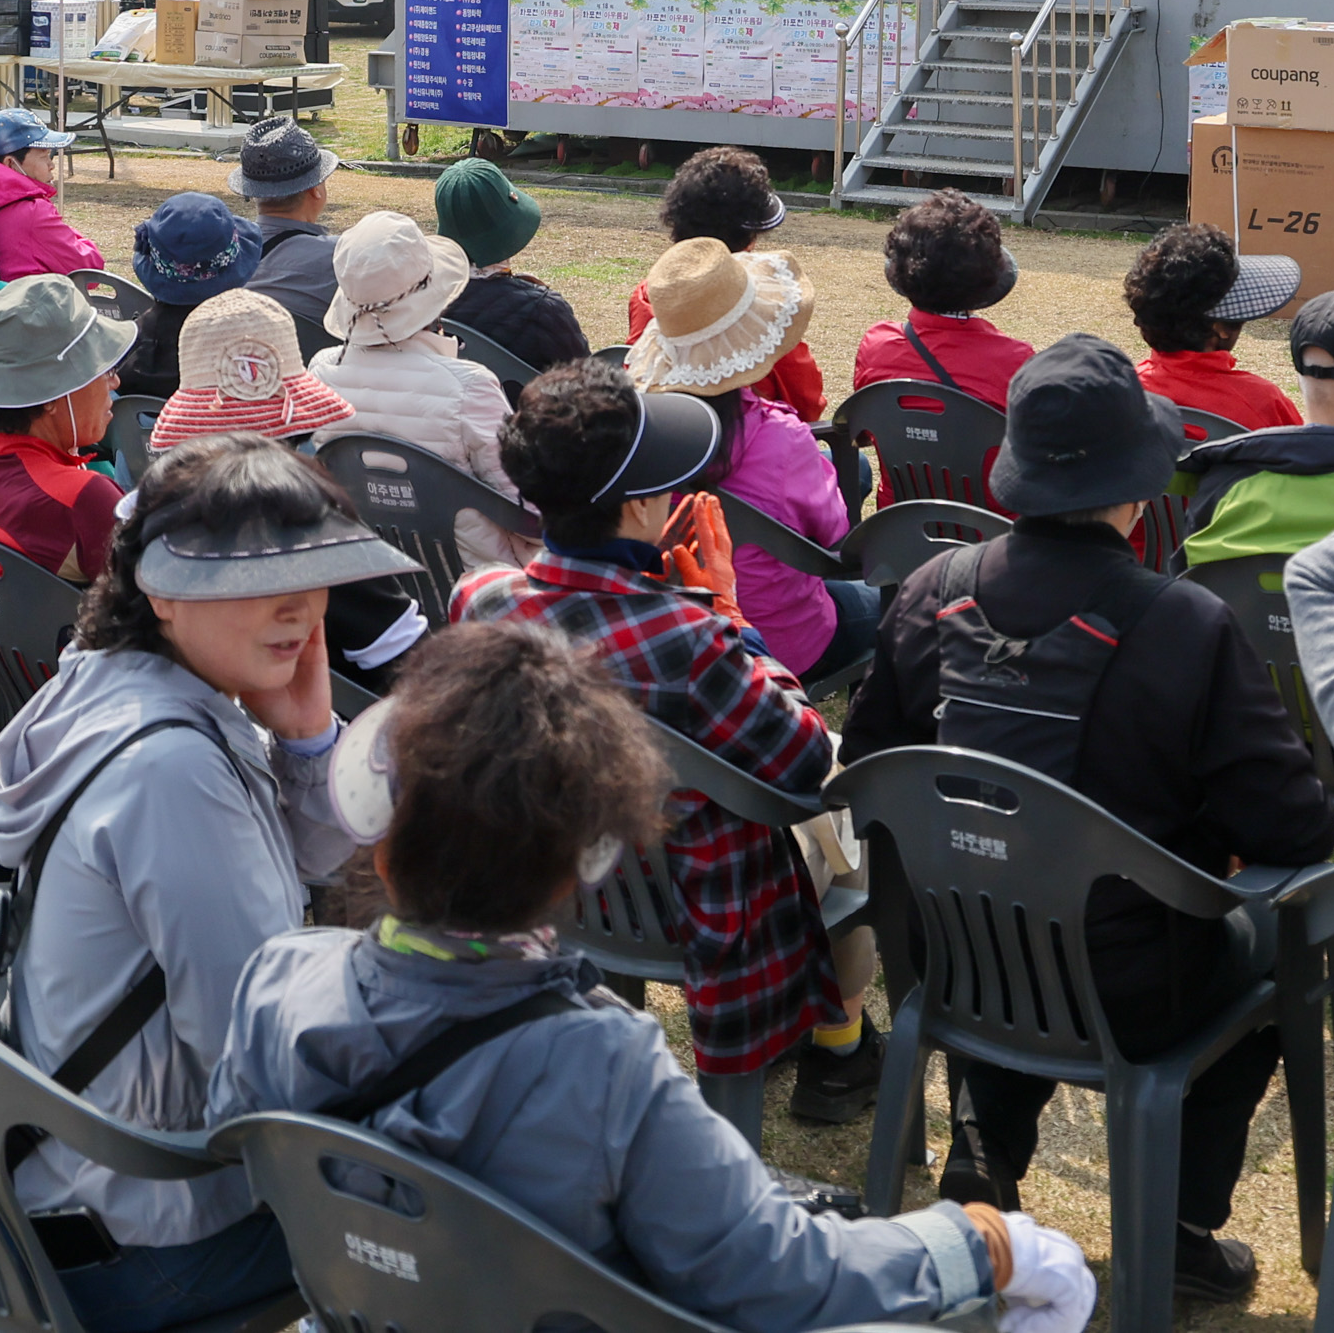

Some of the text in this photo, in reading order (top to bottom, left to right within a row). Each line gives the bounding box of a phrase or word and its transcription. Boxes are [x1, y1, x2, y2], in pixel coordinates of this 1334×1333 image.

[1251, 68, 1319, 87] coupang
[1248, 208, 1321, 235] L-26
[367, 481, 412, 499] 아주렌탈
[951, 829, 1007, 855] 아주렌탈
[344, 1232, 416, 1273] 아주렌탈
